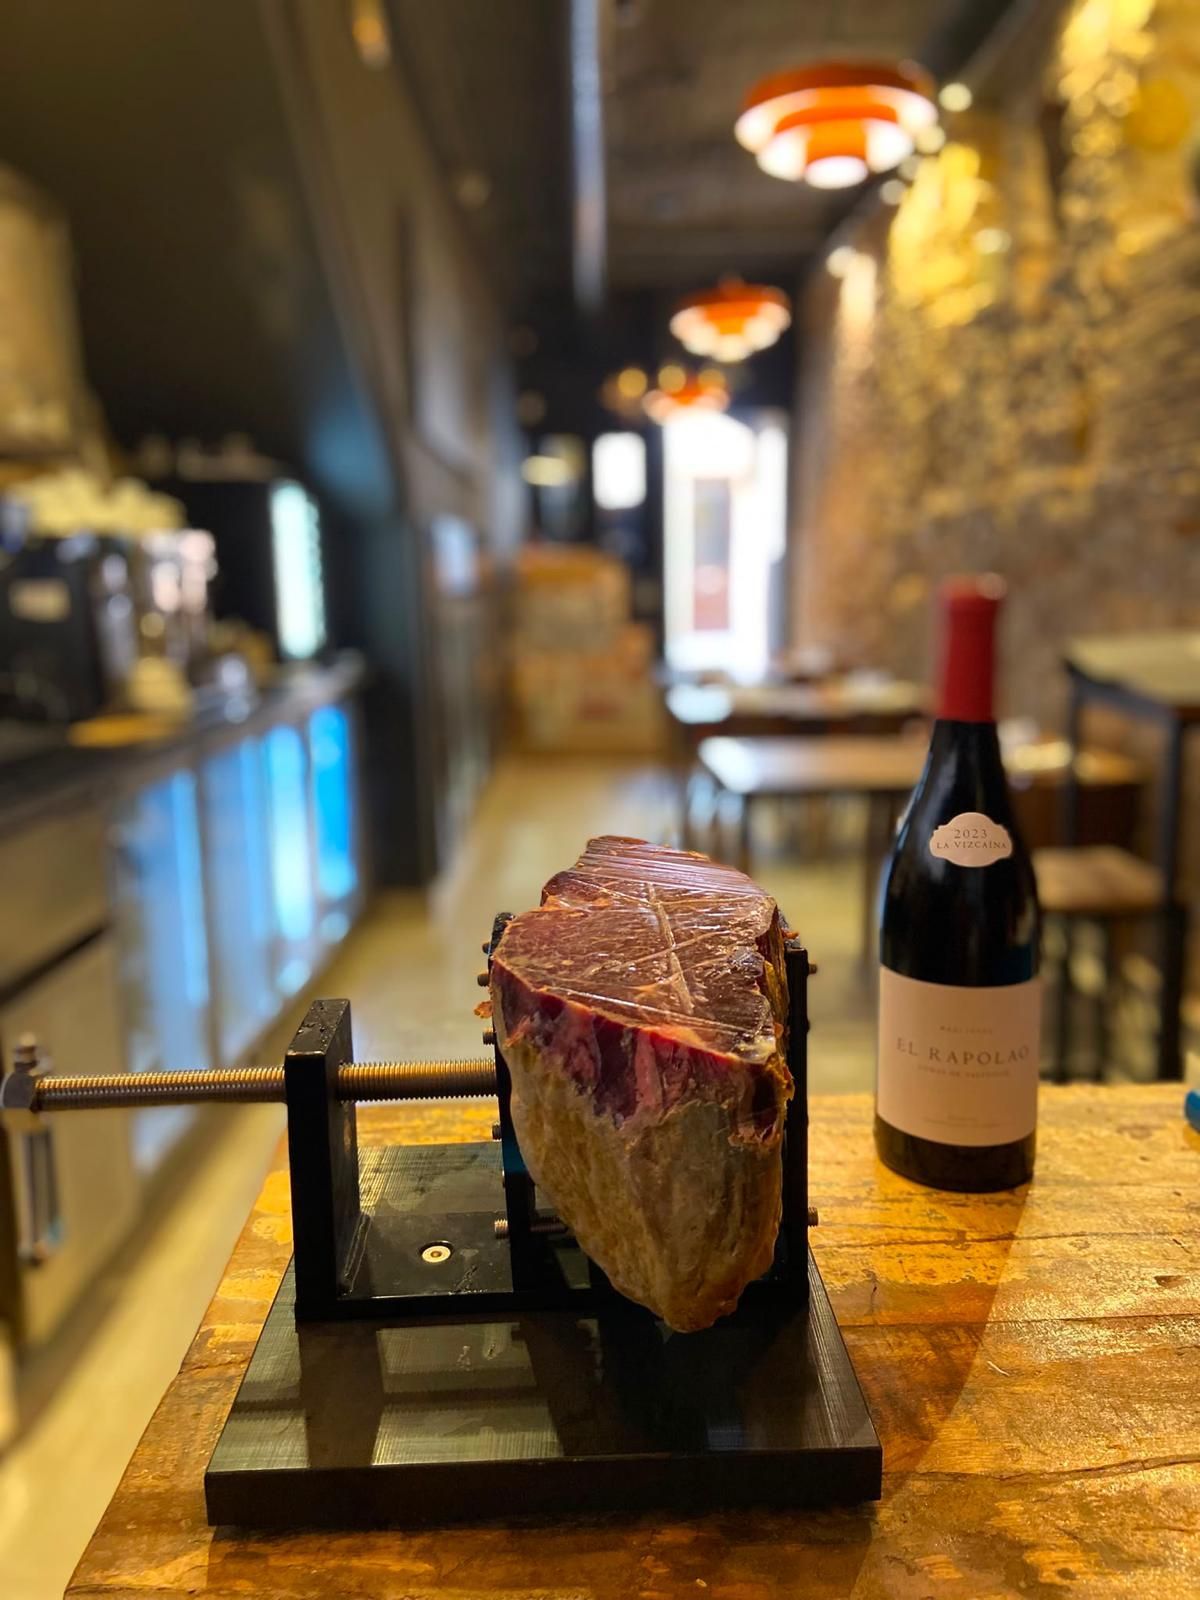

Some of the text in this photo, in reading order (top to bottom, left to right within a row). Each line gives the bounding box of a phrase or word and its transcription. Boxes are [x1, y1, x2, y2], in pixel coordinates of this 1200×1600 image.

[954, 829, 988, 839] 2023
[936, 841, 950, 849] LA
[897, 1037, 1029, 1065] EL RAPOLAO
